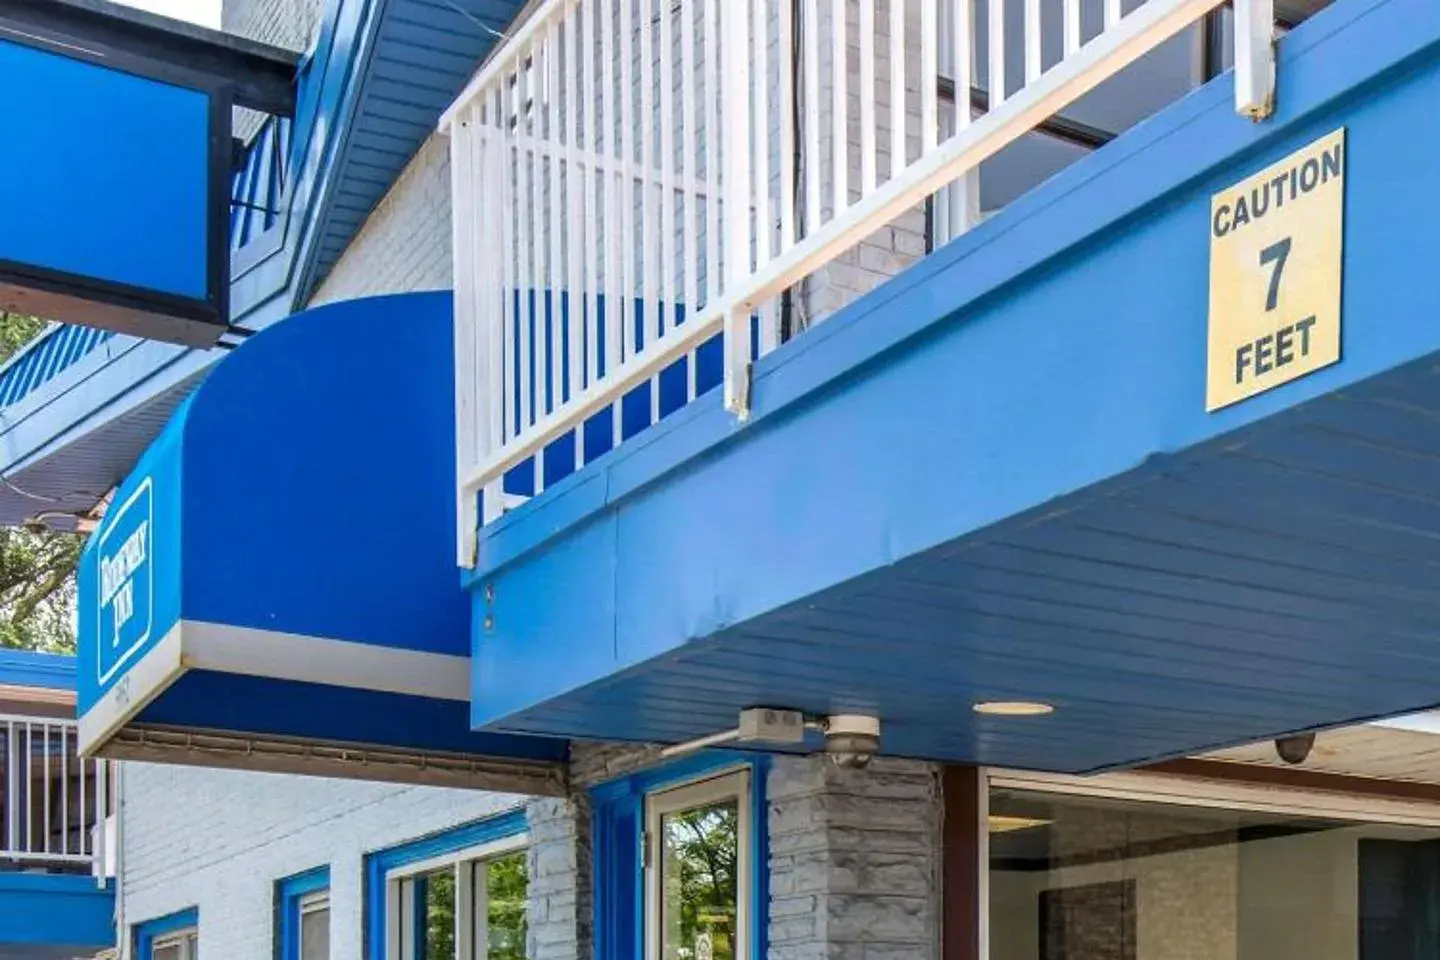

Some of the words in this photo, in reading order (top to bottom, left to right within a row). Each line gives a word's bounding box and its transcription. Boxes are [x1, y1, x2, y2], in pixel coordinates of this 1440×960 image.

[1213, 144, 1341, 237] CAUTION
[1259, 237, 1292, 312] 7
[1235, 315, 1317, 384] FEET
